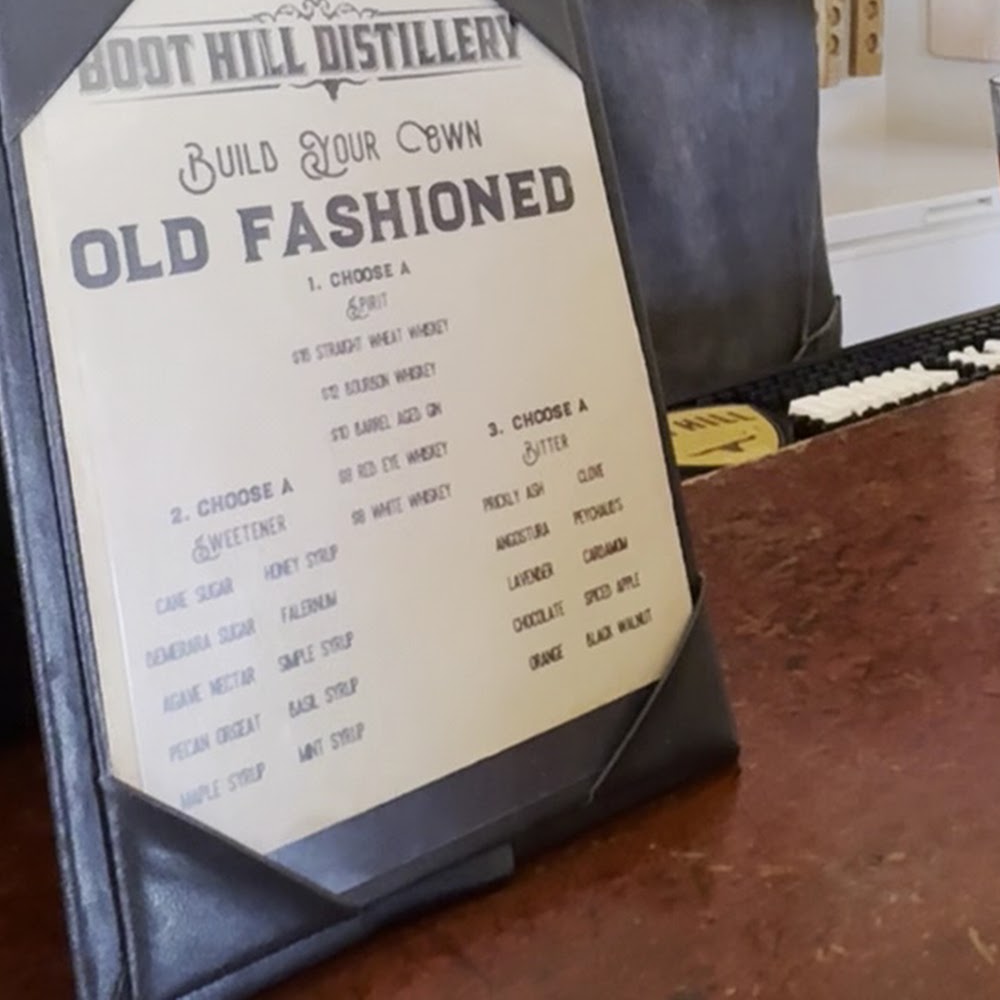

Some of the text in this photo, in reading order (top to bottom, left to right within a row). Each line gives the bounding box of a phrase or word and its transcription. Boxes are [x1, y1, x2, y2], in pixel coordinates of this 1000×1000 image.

[78, 14, 522, 95] BOOT HILL DISTILLERY
[70, 165, 575, 290] OLD FASHIONED
[307, 260, 411, 292] 1. CHOOSE A
[368, 327, 403, 349] WHEAT
[408, 317, 449, 340] WHISKEY
[394, 361, 437, 385] WHISKEY
[397, 405, 422, 427] AGED
[488, 397, 589, 438] 3. CHOOSE A
[381, 453, 401, 473] EYE
[405, 441, 449, 466] WHISKEY
[521, 433, 570, 467] BITTER
[170, 477, 295, 525] 2. CHOOSE A
[407, 482, 452, 508] WHISKEY
[525, 481, 546, 500] ASH
[191, 513, 288, 564] SWEETENER
[495, 521, 551, 552] ANGOSTURA
[264, 543, 339, 581] HONEY SYRUP
[507, 561, 554, 592] LAVENDER
[155, 576, 234, 616] CANE SUGAR
[280, 589, 338, 623] FALERNUM
[583, 571, 641, 607] SPICED APPLE
[217, 617, 256, 645] SUGAR
[512, 600, 565, 634] CHOCOLATE
[585, 607, 653, 648] BLACK WALNUT
[277, 630, 354, 673] SIMPLE SYRUP
[529, 643, 564, 671] ORANGE
[162, 665, 257, 713] AGAVE NECTAR
[325, 675, 359, 704] SYRUP
[168, 732, 211, 763] PECAN
[298, 721, 366, 764] MINT SYRUP
[227, 761, 265, 792] SYRUP
